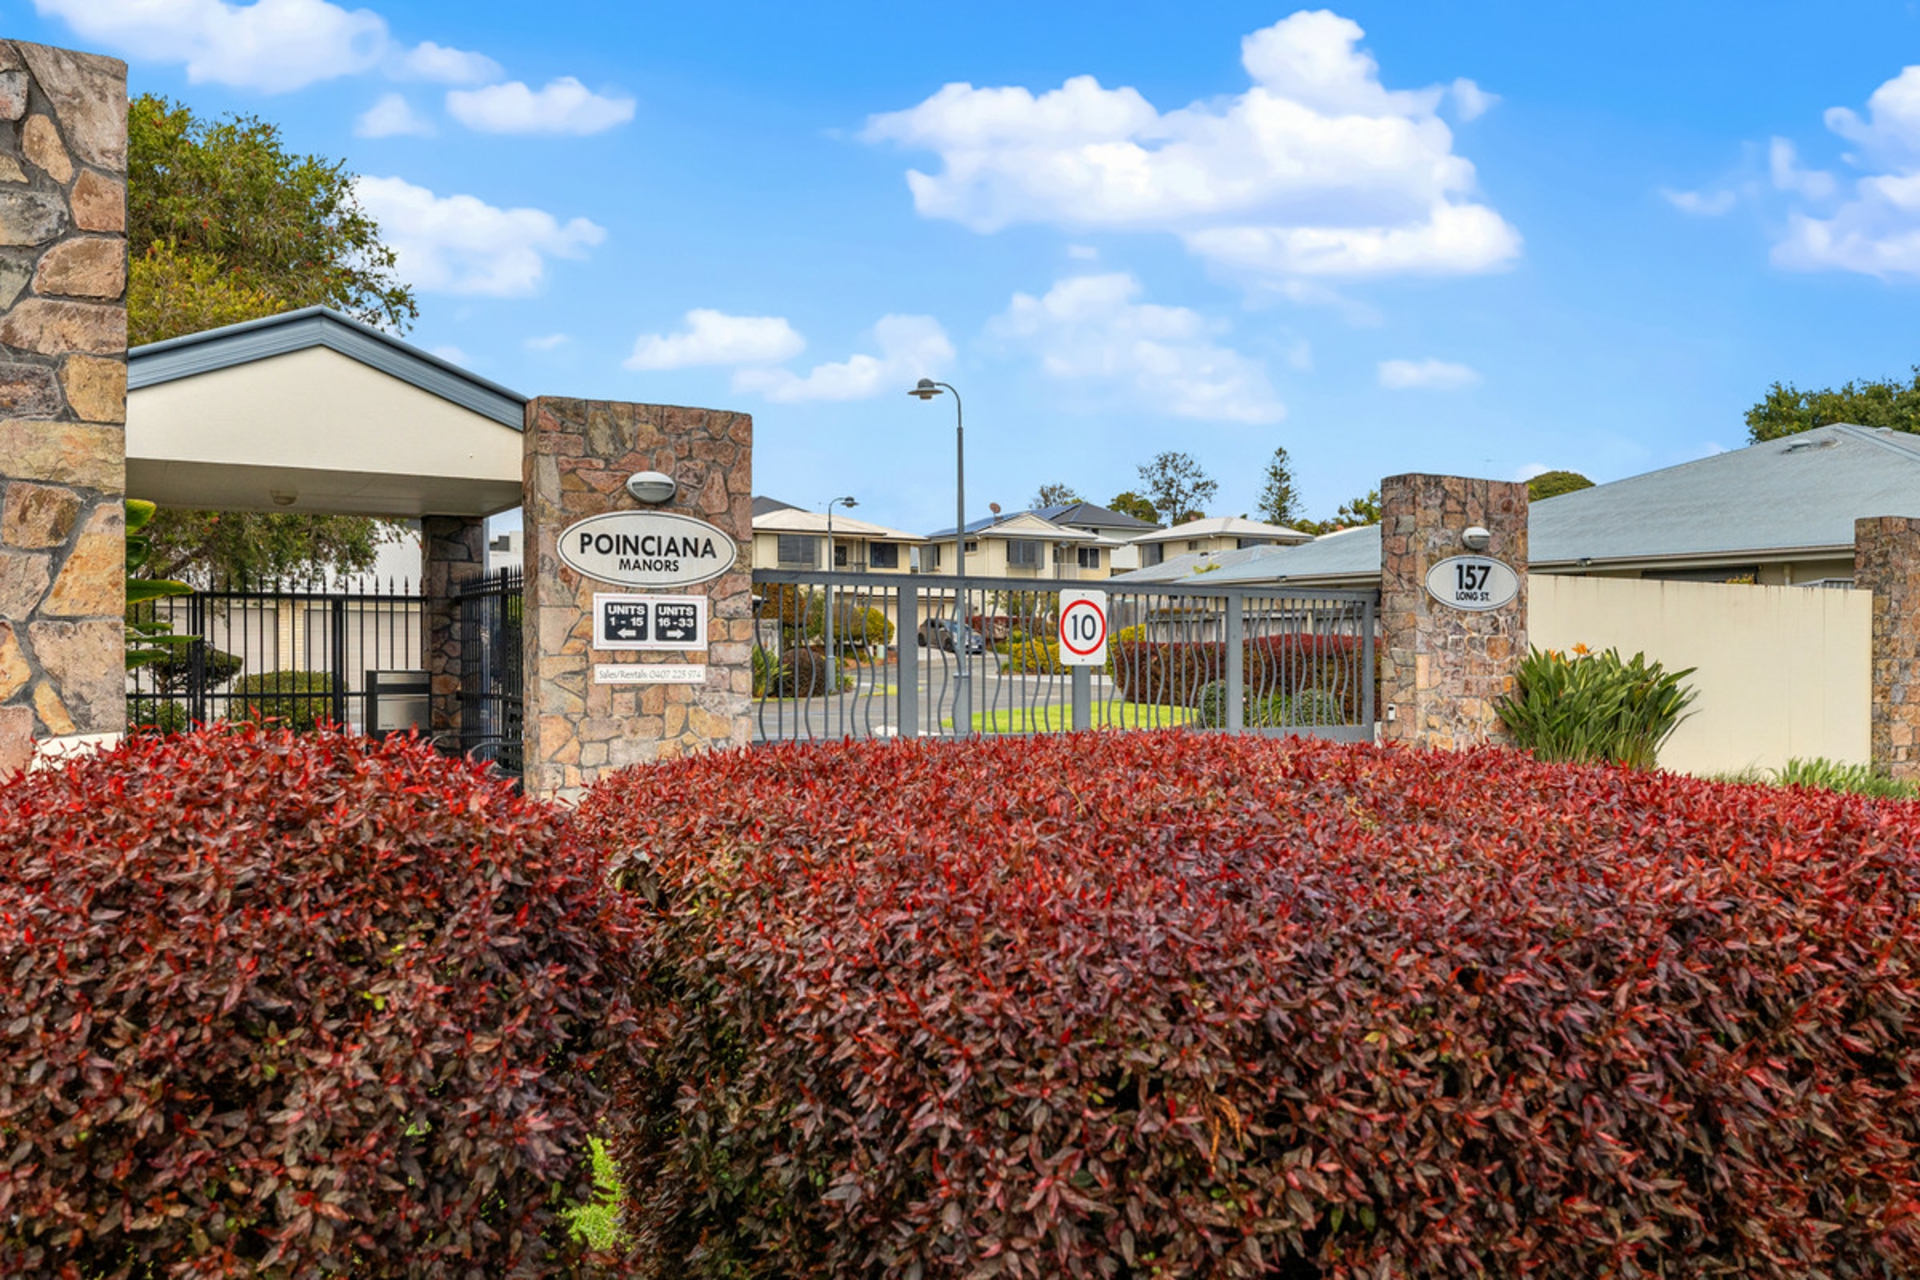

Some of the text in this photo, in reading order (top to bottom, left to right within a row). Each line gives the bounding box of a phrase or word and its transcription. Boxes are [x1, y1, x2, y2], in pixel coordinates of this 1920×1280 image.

[579, 533, 717, 559] POINCIANA
[618, 558, 679, 572] MANORS
[1456, 564, 1492, 591] 157
[1455, 592, 1479, 601] LONG
[608, 604, 646, 615] UNITS
[658, 606, 694, 616] UNITS
[609, 617, 616, 626] 1
[630, 617, 644, 626] 15
[1071, 614, 1097, 641] 10
